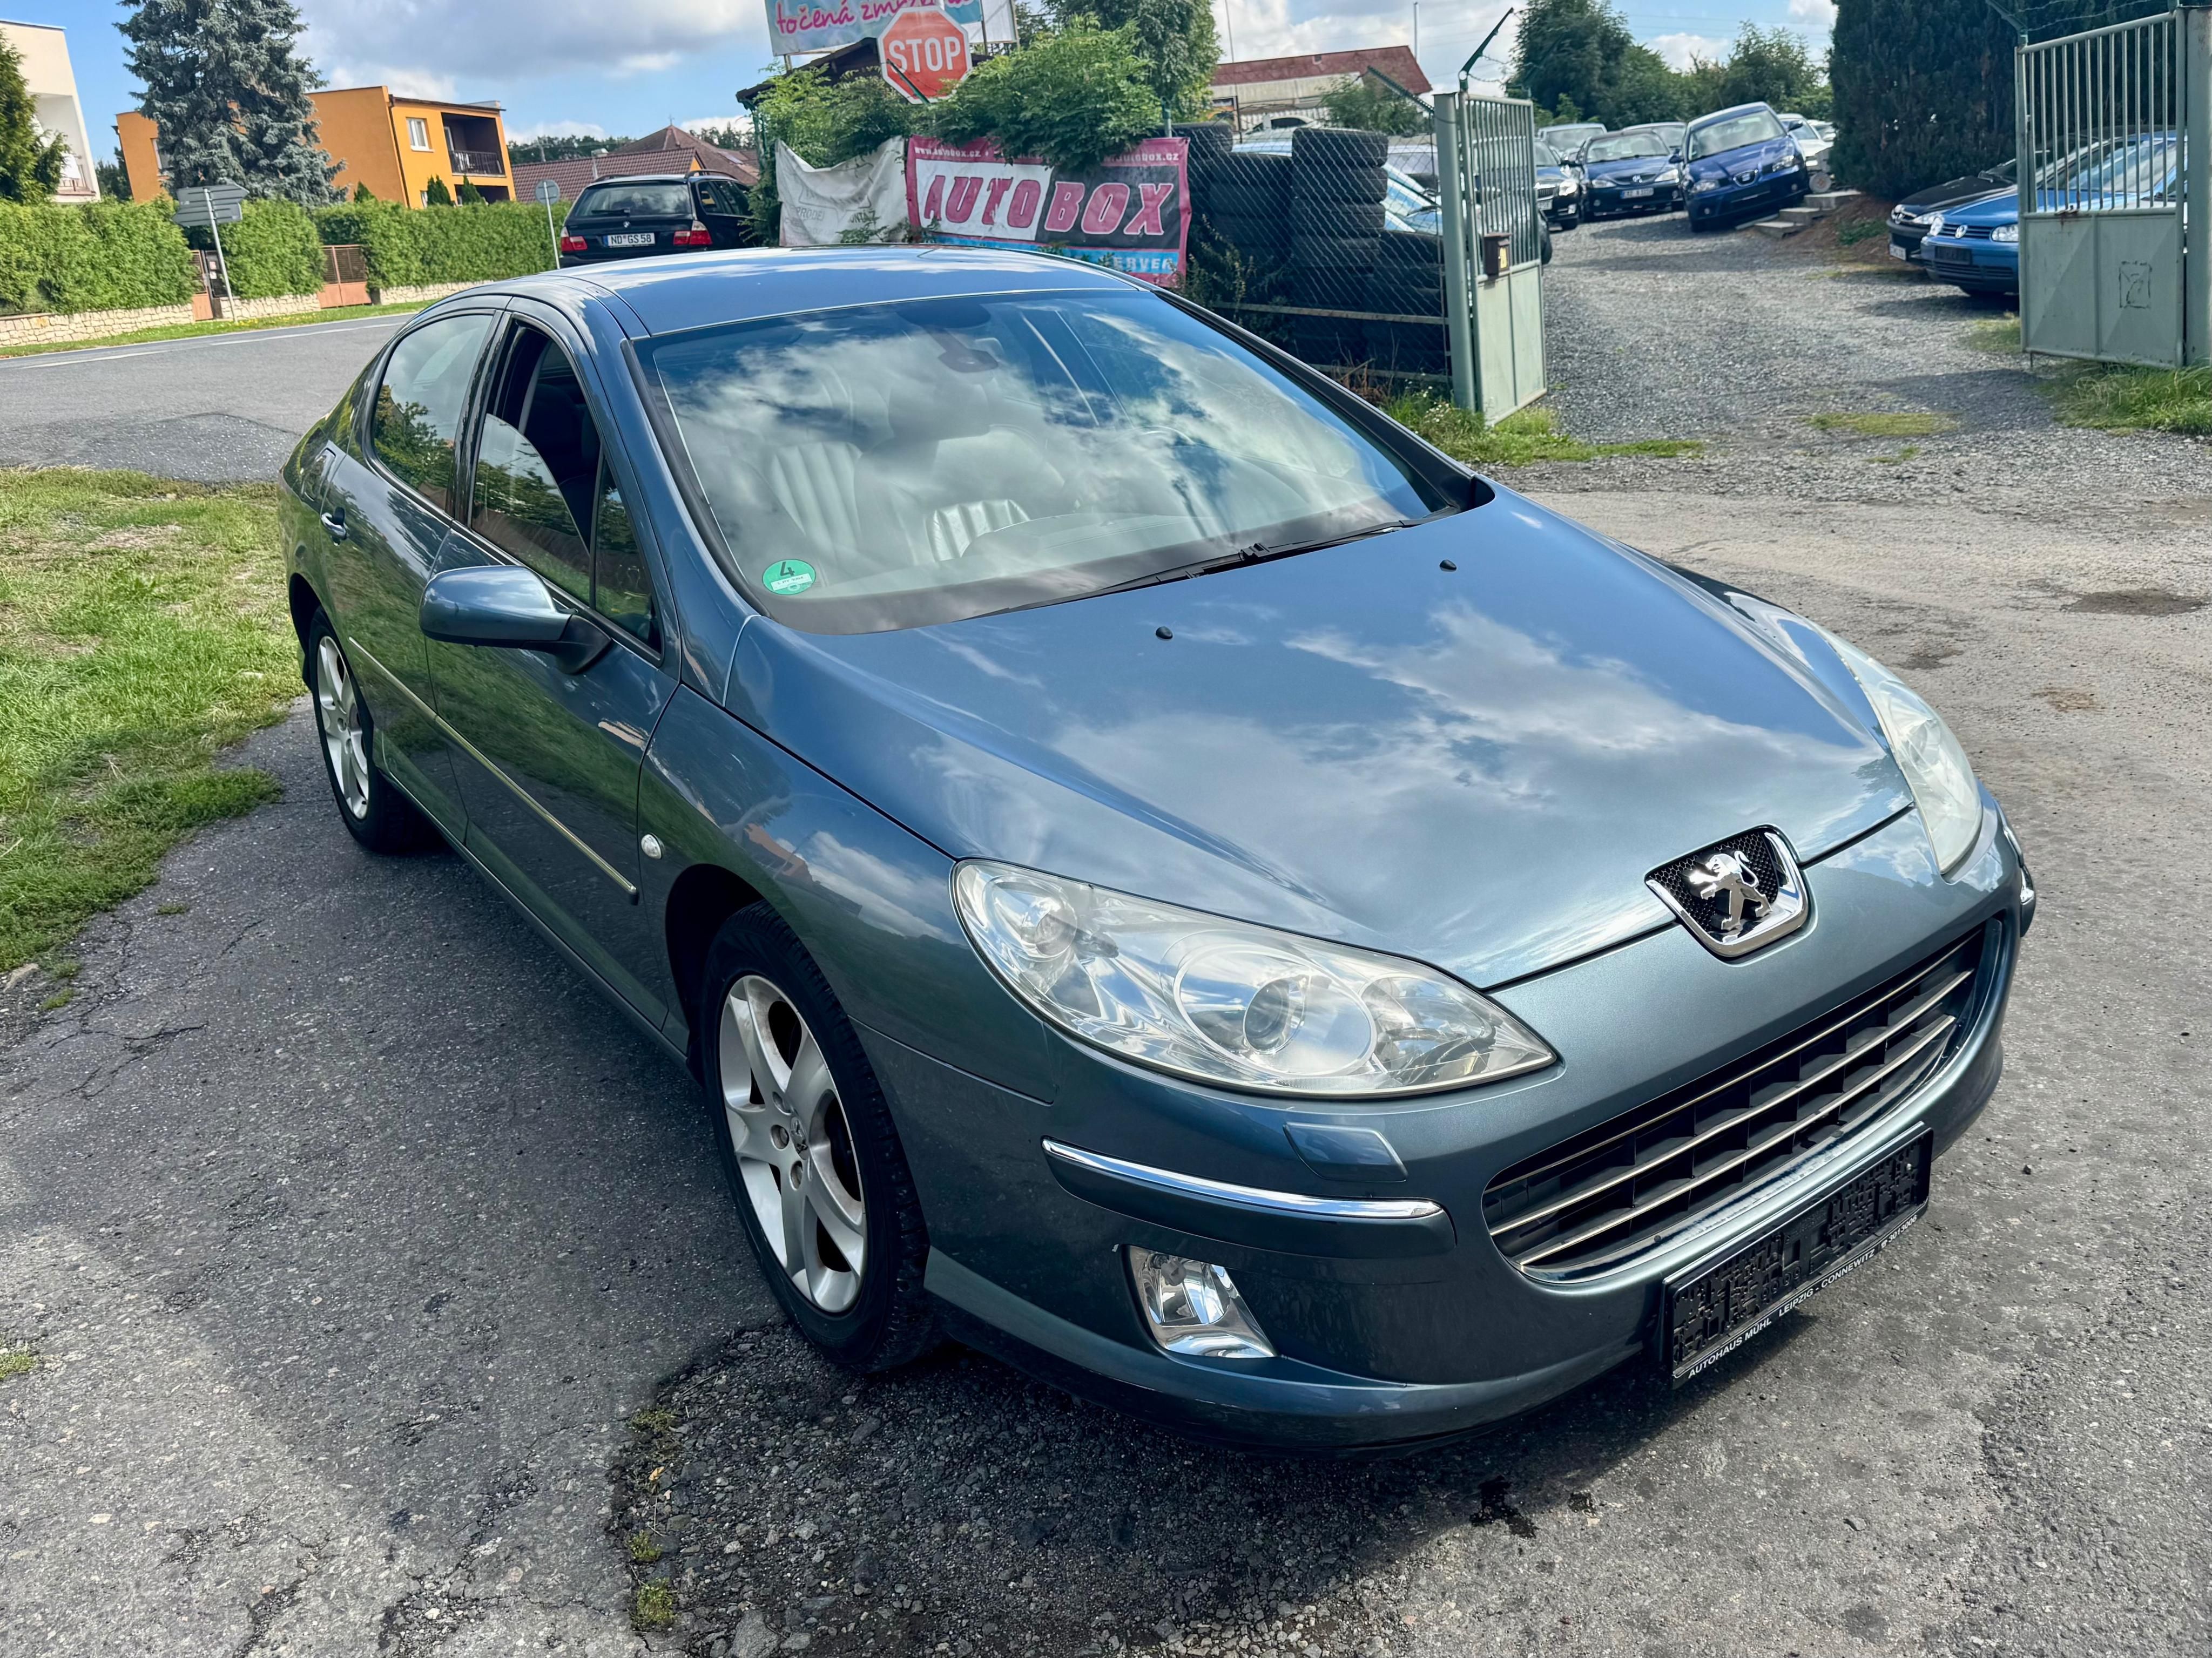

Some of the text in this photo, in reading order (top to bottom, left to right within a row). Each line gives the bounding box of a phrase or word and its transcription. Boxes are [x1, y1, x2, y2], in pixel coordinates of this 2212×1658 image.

[889, 36, 960, 73] STOP
[923, 174, 1174, 236] AUTOBOX
[611, 234, 651, 245] ND GS 58
[780, 561, 795, 576] 4
[1688, 1337, 1743, 1379] AUTOHAUS
[1744, 1317, 1772, 1341] MÜHL
[1778, 1288, 1814, 1317] LEIPZIG
[1820, 1248, 1876, 1289] CONNEWITZ
